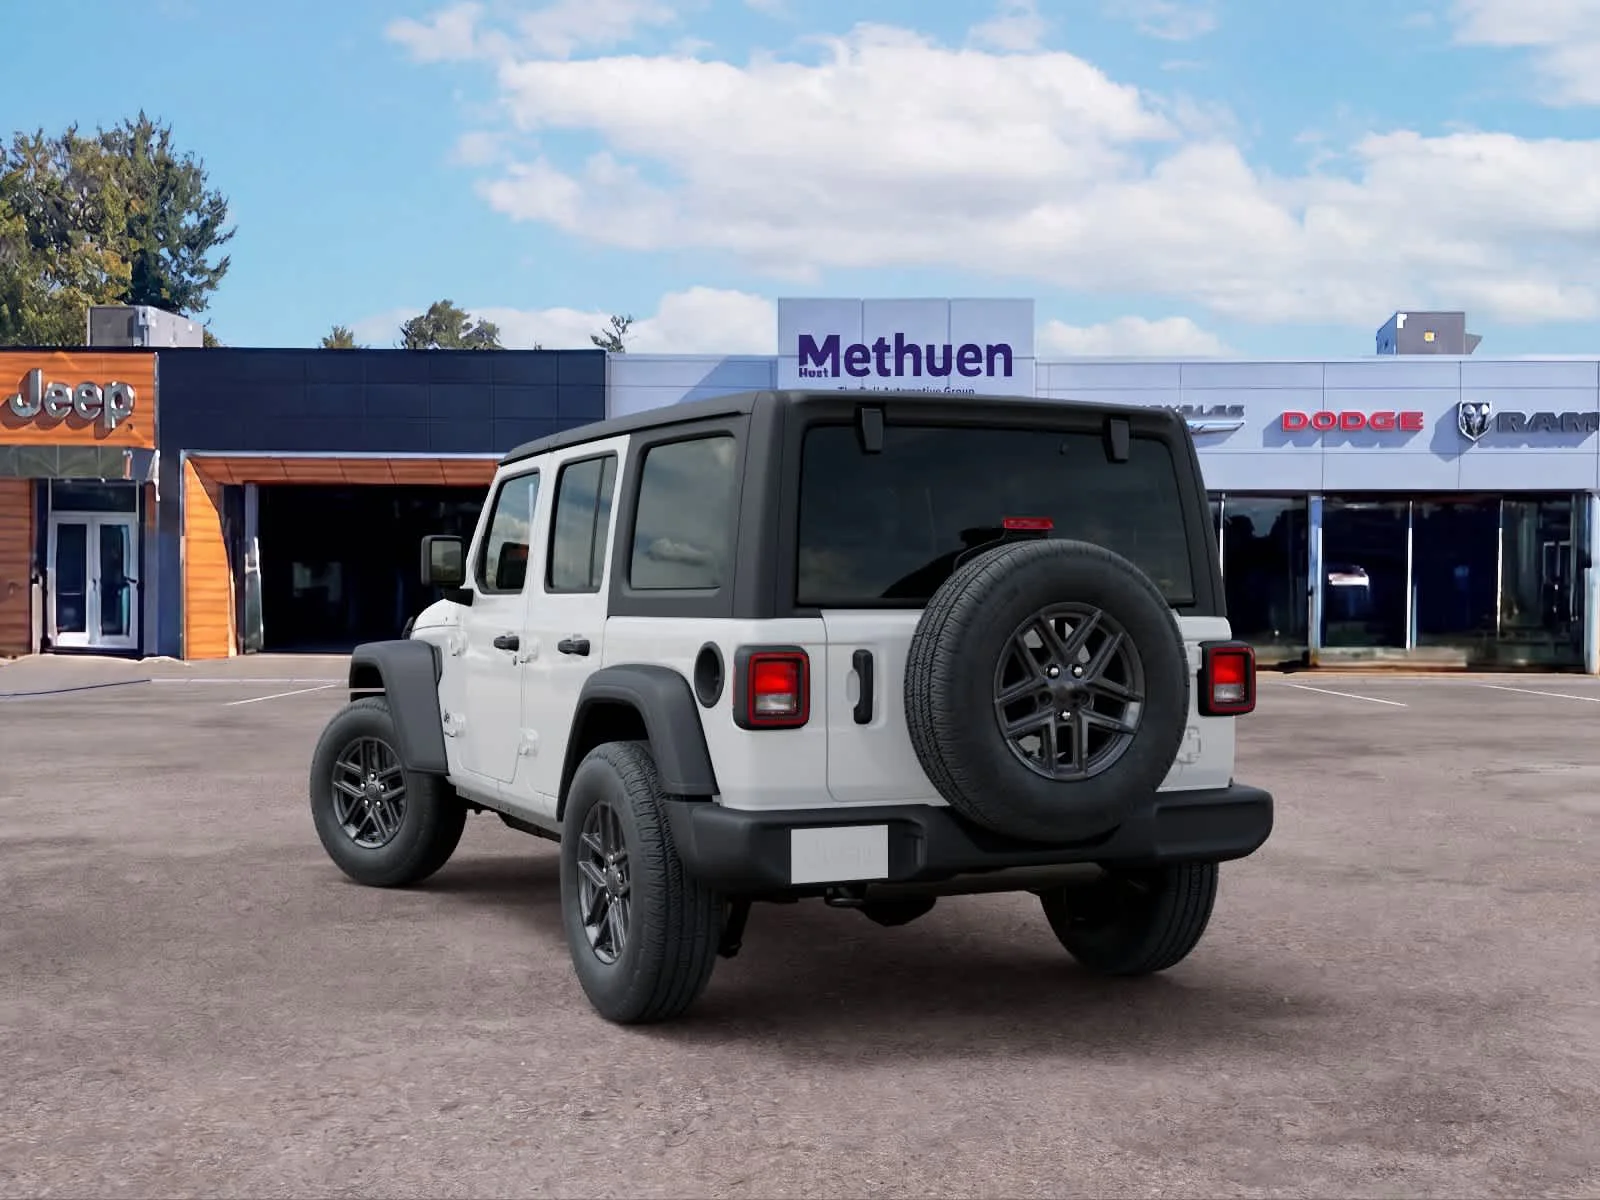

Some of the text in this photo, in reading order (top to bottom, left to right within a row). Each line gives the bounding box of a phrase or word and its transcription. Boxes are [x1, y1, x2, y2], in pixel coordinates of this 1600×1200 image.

[799, 333, 1013, 377] Methuen
[10, 368, 136, 430] Jeep
[1281, 410, 1424, 432] DODGE
[1497, 412, 1600, 433] RAM
